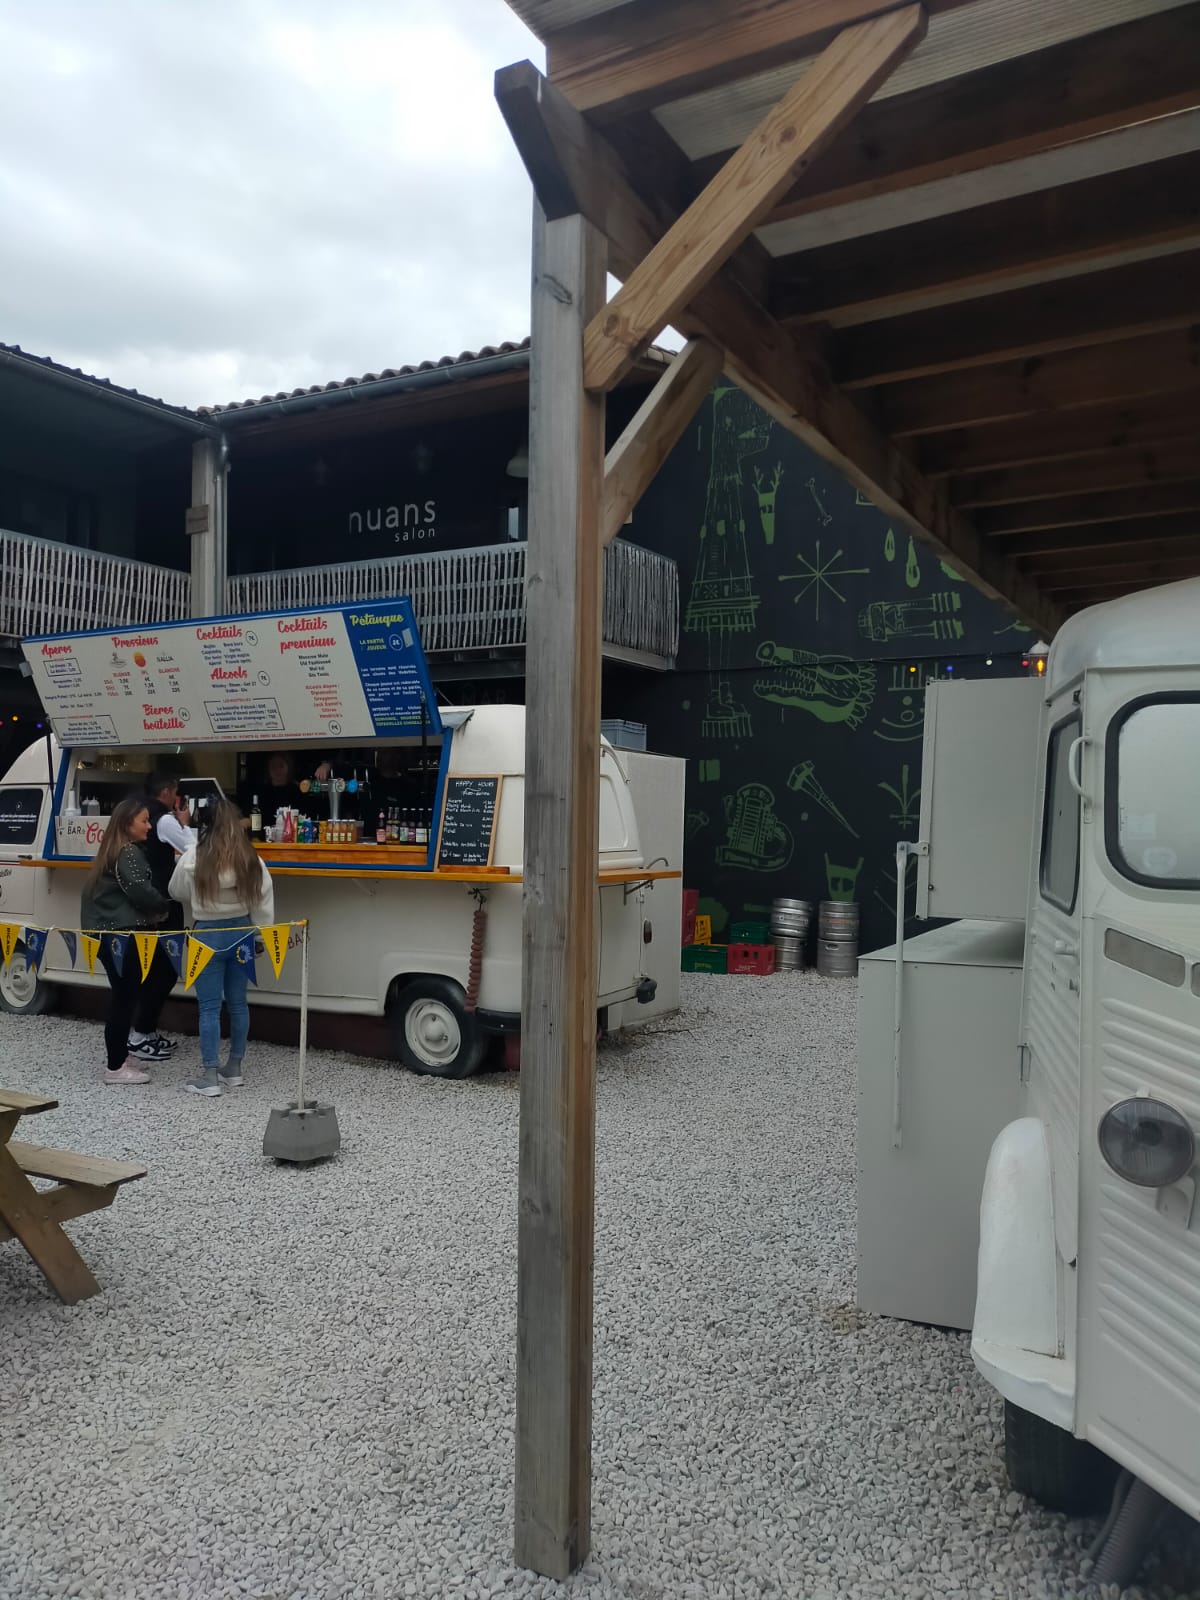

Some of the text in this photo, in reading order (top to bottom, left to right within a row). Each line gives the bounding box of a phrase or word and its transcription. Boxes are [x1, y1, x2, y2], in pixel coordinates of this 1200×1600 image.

[349, 500, 436, 534] nuans
[394, 527, 435, 542] salon
[196, 625, 243, 640] Cocktails
[278, 617, 328, 633] Cocktails
[111, 635, 159, 648] Pressions
[280, 636, 336, 654] premium
[210, 666, 248, 680] Alcools
[143, 718, 186, 730] bouteille
[67, 826, 82, 835] BAR
[272, 930, 280, 965] RICARD
[189, 945, 204, 978] RICARD
